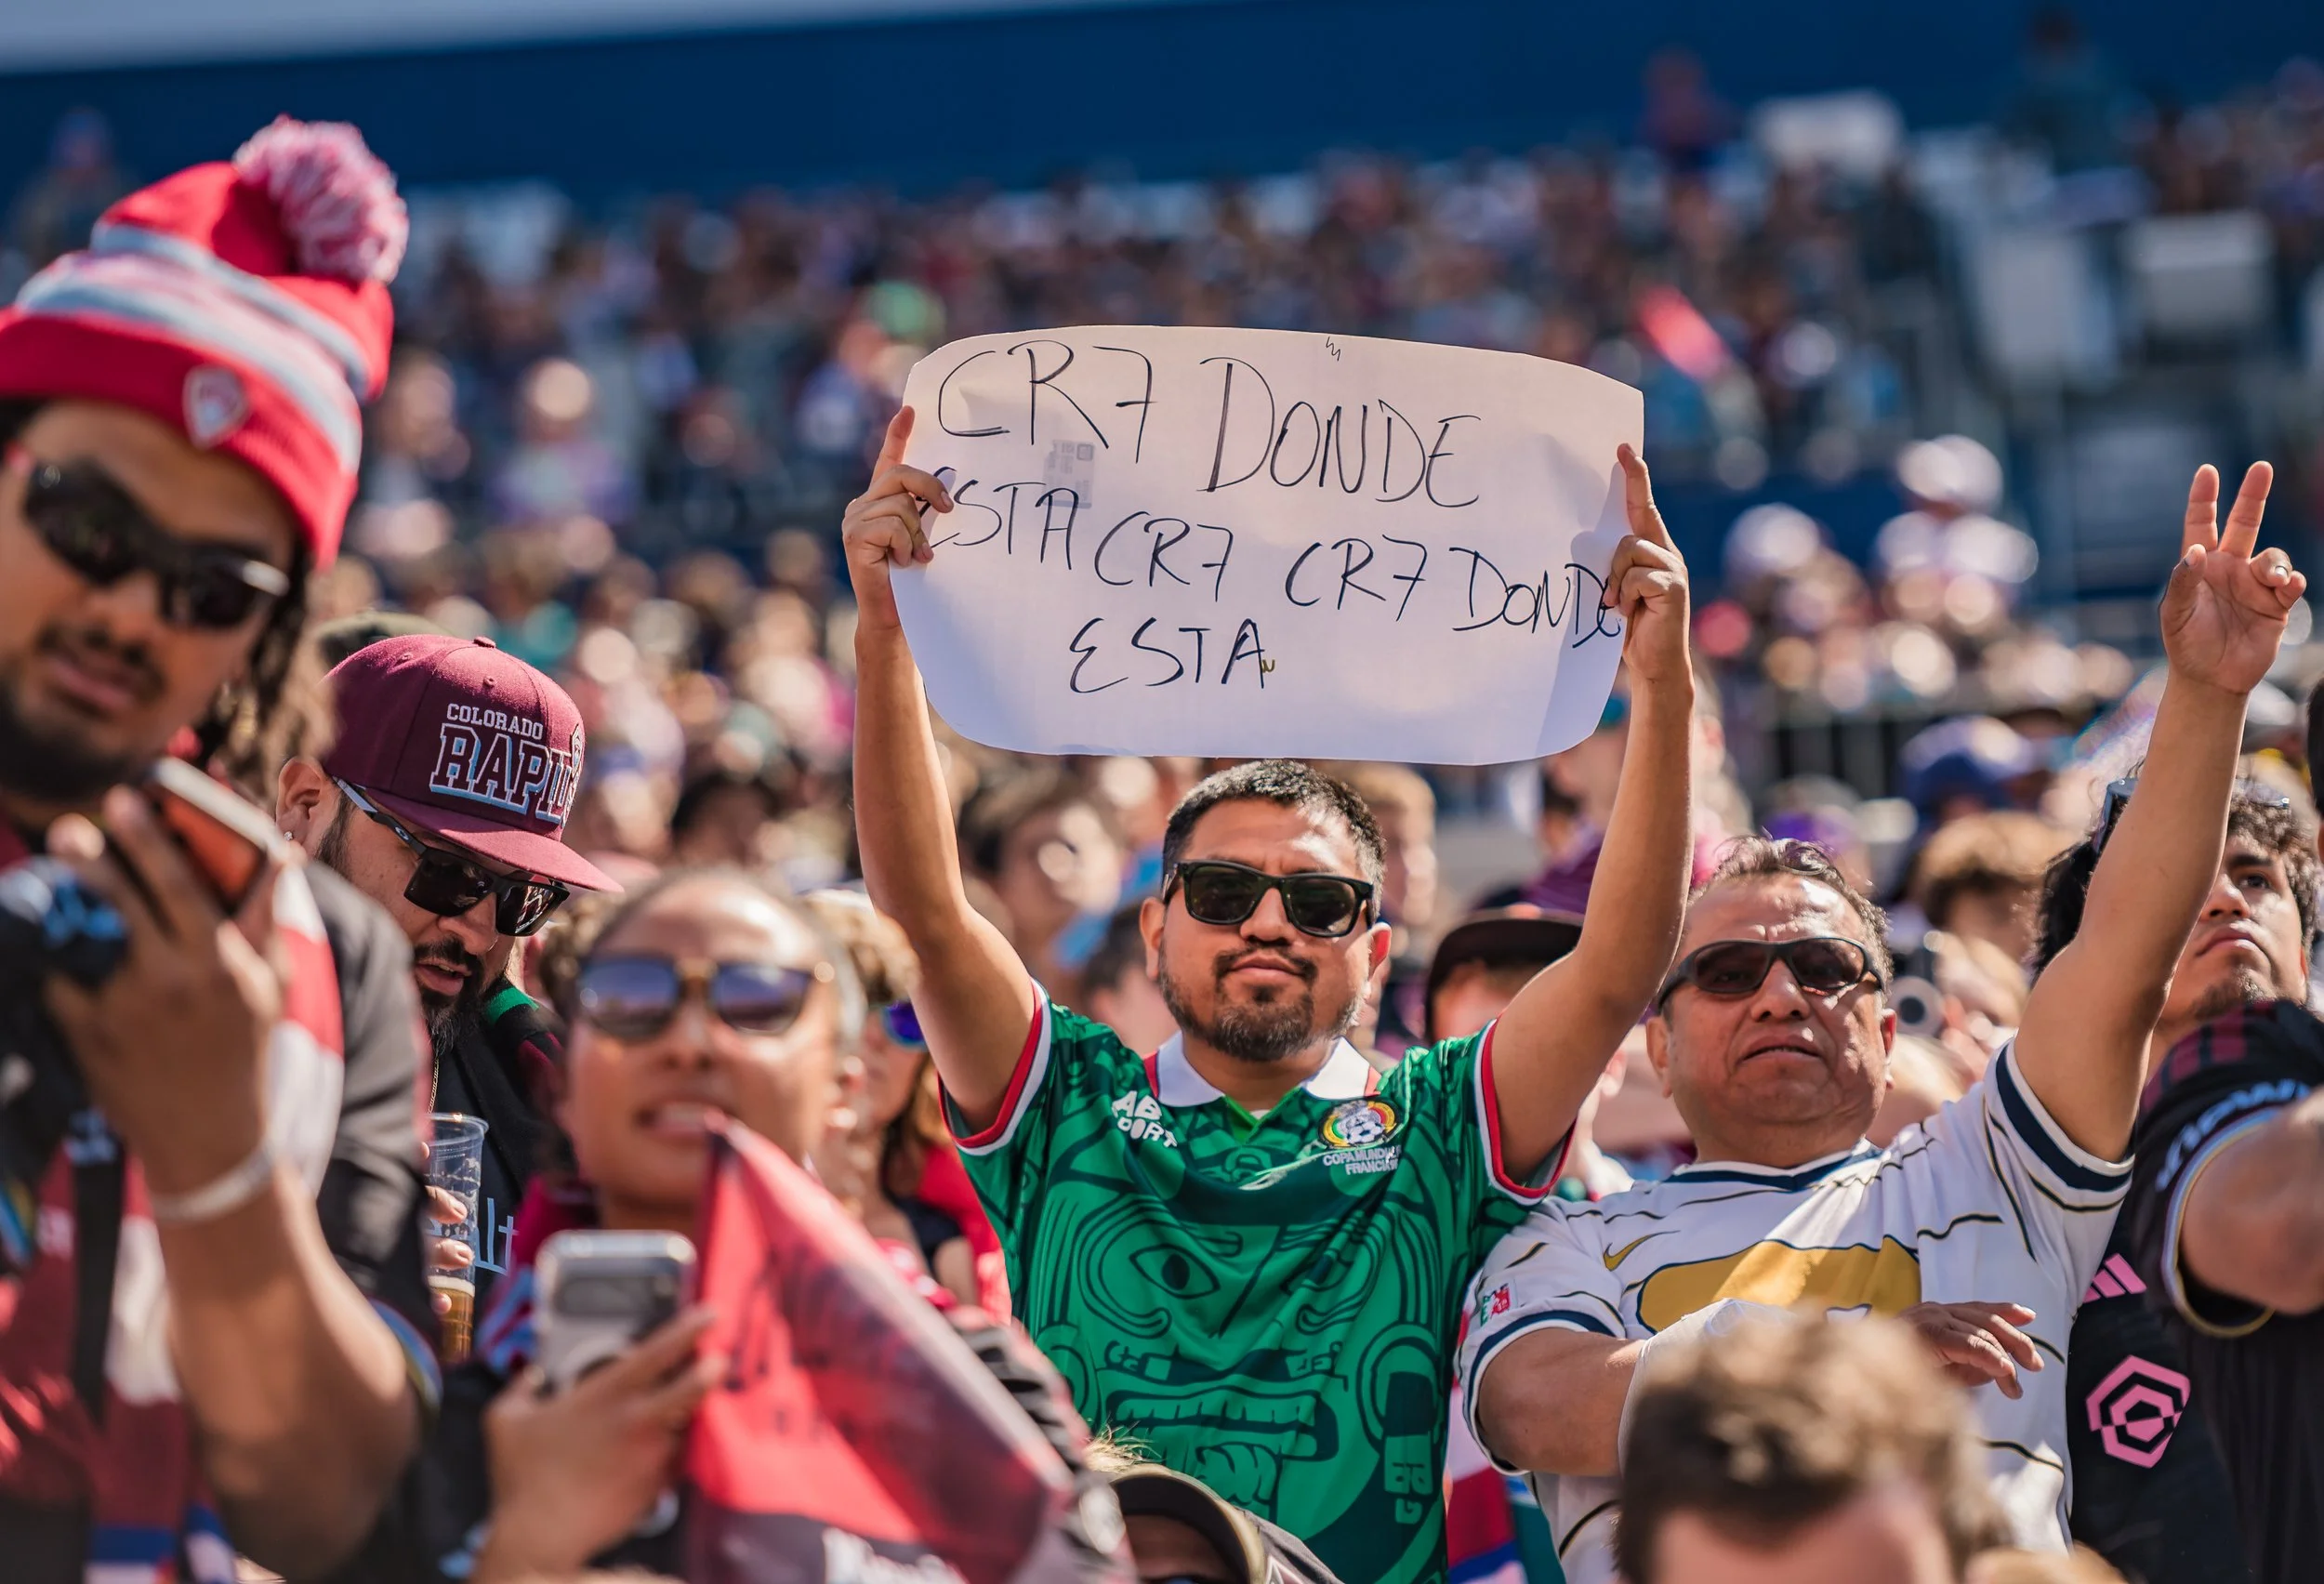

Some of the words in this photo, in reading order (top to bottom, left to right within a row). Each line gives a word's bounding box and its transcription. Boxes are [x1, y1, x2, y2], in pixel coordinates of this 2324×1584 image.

[937, 339, 1158, 464] CR7
[1199, 357, 1482, 508] DONDE
[1094, 511, 1234, 602] CR7
[1285, 534, 1427, 622] CR7
[1069, 616, 1265, 693] ESTA
[446, 703, 544, 740] COLORADO
[1323, 1150, 1356, 1167] COPA
